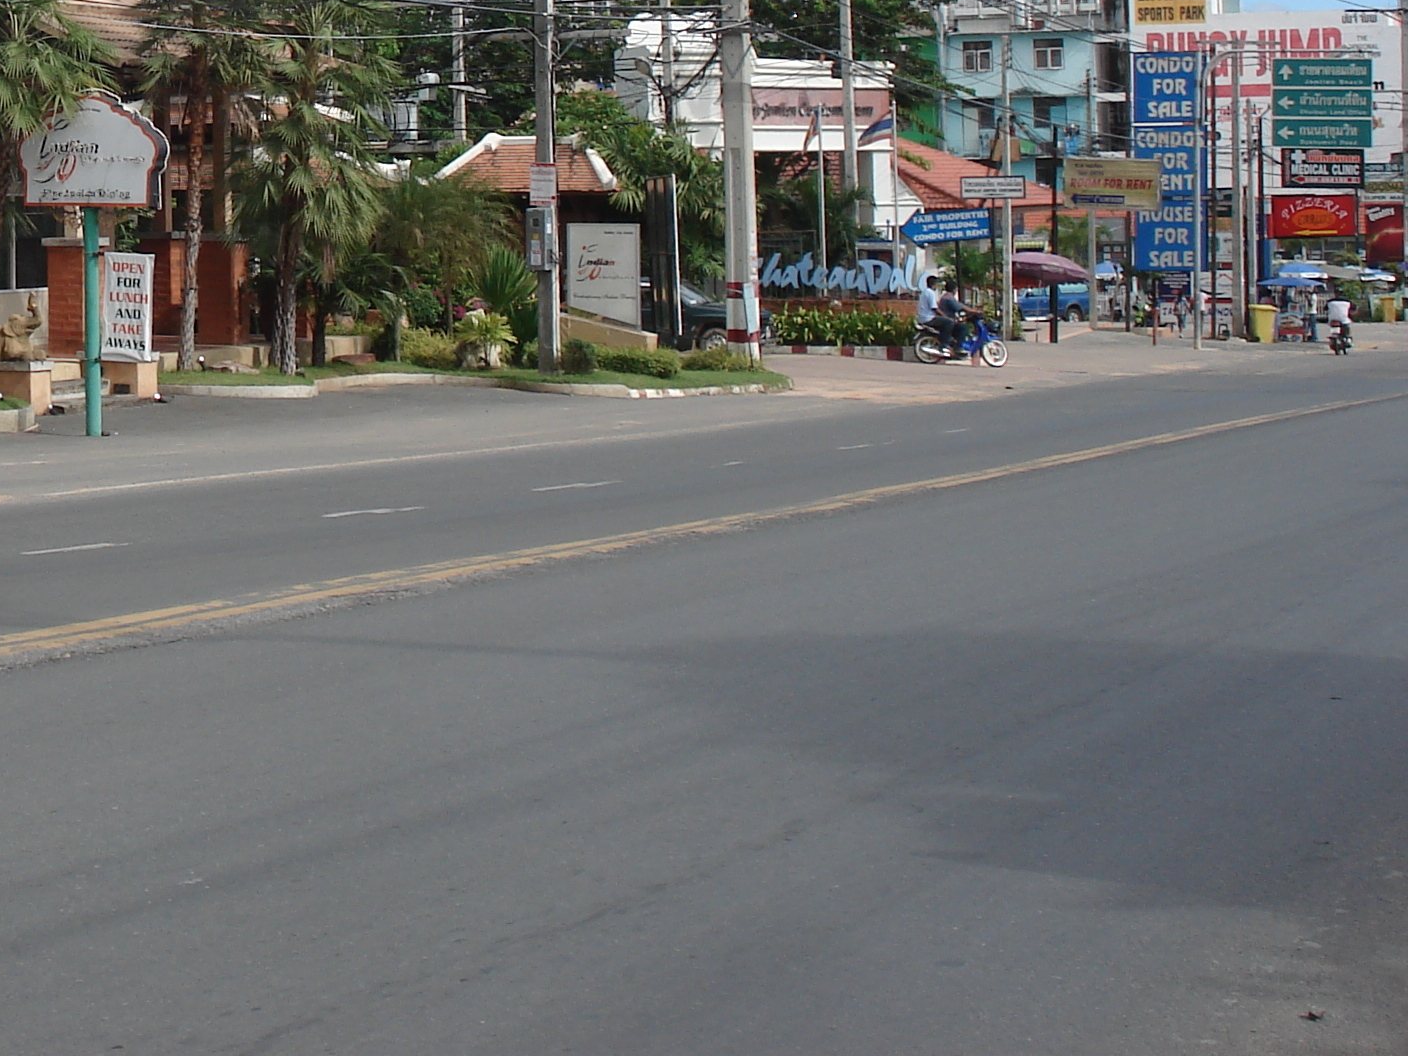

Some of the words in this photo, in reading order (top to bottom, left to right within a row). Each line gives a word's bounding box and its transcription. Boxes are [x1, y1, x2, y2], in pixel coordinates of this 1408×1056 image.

[1137, 6, 1174, 21] SPORTS
[1179, 5, 1205, 21] PARK
[1256, 27, 1342, 77] JUMP
[1152, 78, 1187, 96] FOR
[1147, 101, 1193, 119] SALE
[1291, 163, 1329, 175] MEDICAL
[1331, 163, 1360, 175] CLINIC
[1070, 178, 1101, 189] ROOM
[1104, 178, 1123, 190] FOR
[1126, 179, 1154, 191] RENT
[1161, 174, 1194, 191] ENT
[1281, 198, 1348, 220] PIZZERIA
[912, 214, 934, 224] FAIR
[936, 210, 989, 222] PROPERTIES
[939, 221, 979, 231] BUILDING
[913, 232, 945, 242] CONDO
[946, 230, 964, 239] FOR
[966, 228, 990, 237] RENT
[1154, 227, 1189, 245] FOR
[1149, 250, 1195, 268] SALE
[112, 261, 145, 274] OPEN
[116, 277, 141, 289] FOR
[109, 293, 149, 305] LUNCH
[115, 308, 141, 320] AND
[112, 323, 142, 335] TAKE
[105, 336, 146, 351] AWAYS
